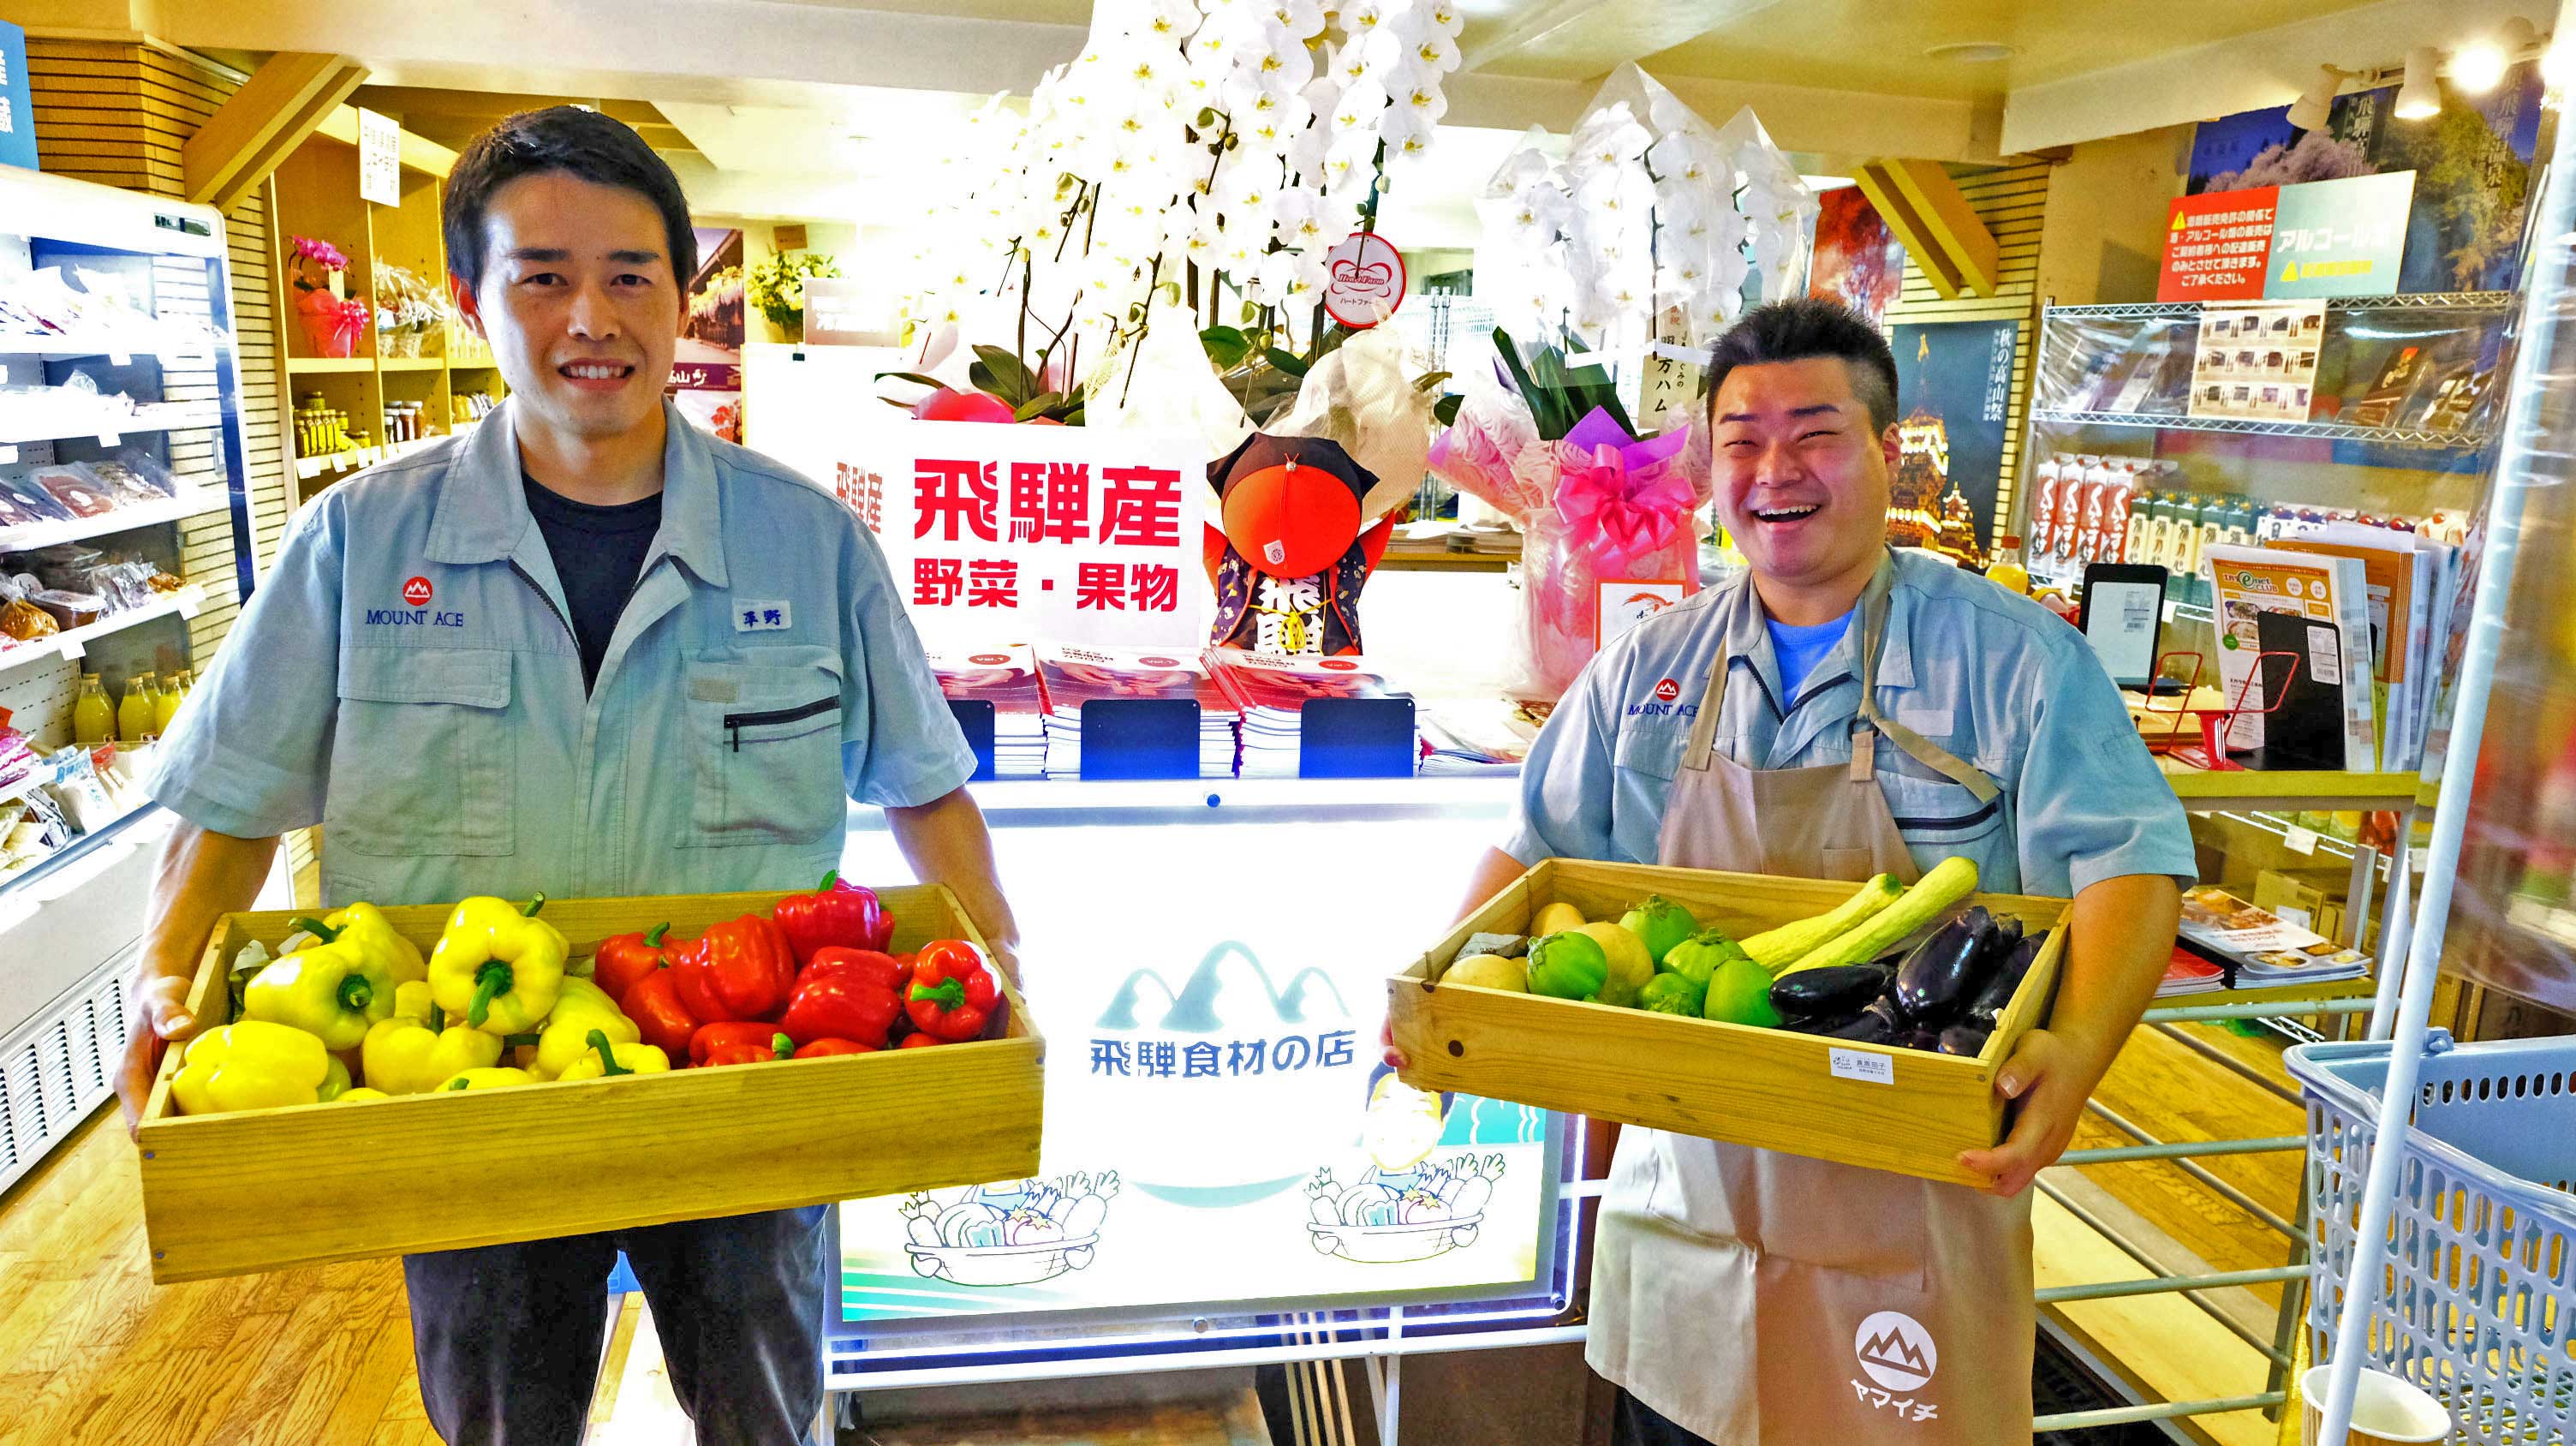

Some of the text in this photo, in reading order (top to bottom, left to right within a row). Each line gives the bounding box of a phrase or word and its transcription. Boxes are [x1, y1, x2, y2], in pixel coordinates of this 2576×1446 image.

[2181, 272, 2246, 286] ご了承ください。
[914, 458, 1182, 547] 飛騨産
[913, 558, 1178, 612] 野菜・果物
[366, 609, 464, 627] MOUNT ACE
[1628, 703, 1672, 715] MOUNT
[1090, 1030, 1357, 1079] 飛騨食材の店
[1851, 1378, 1938, 1422] ヤマイチ
